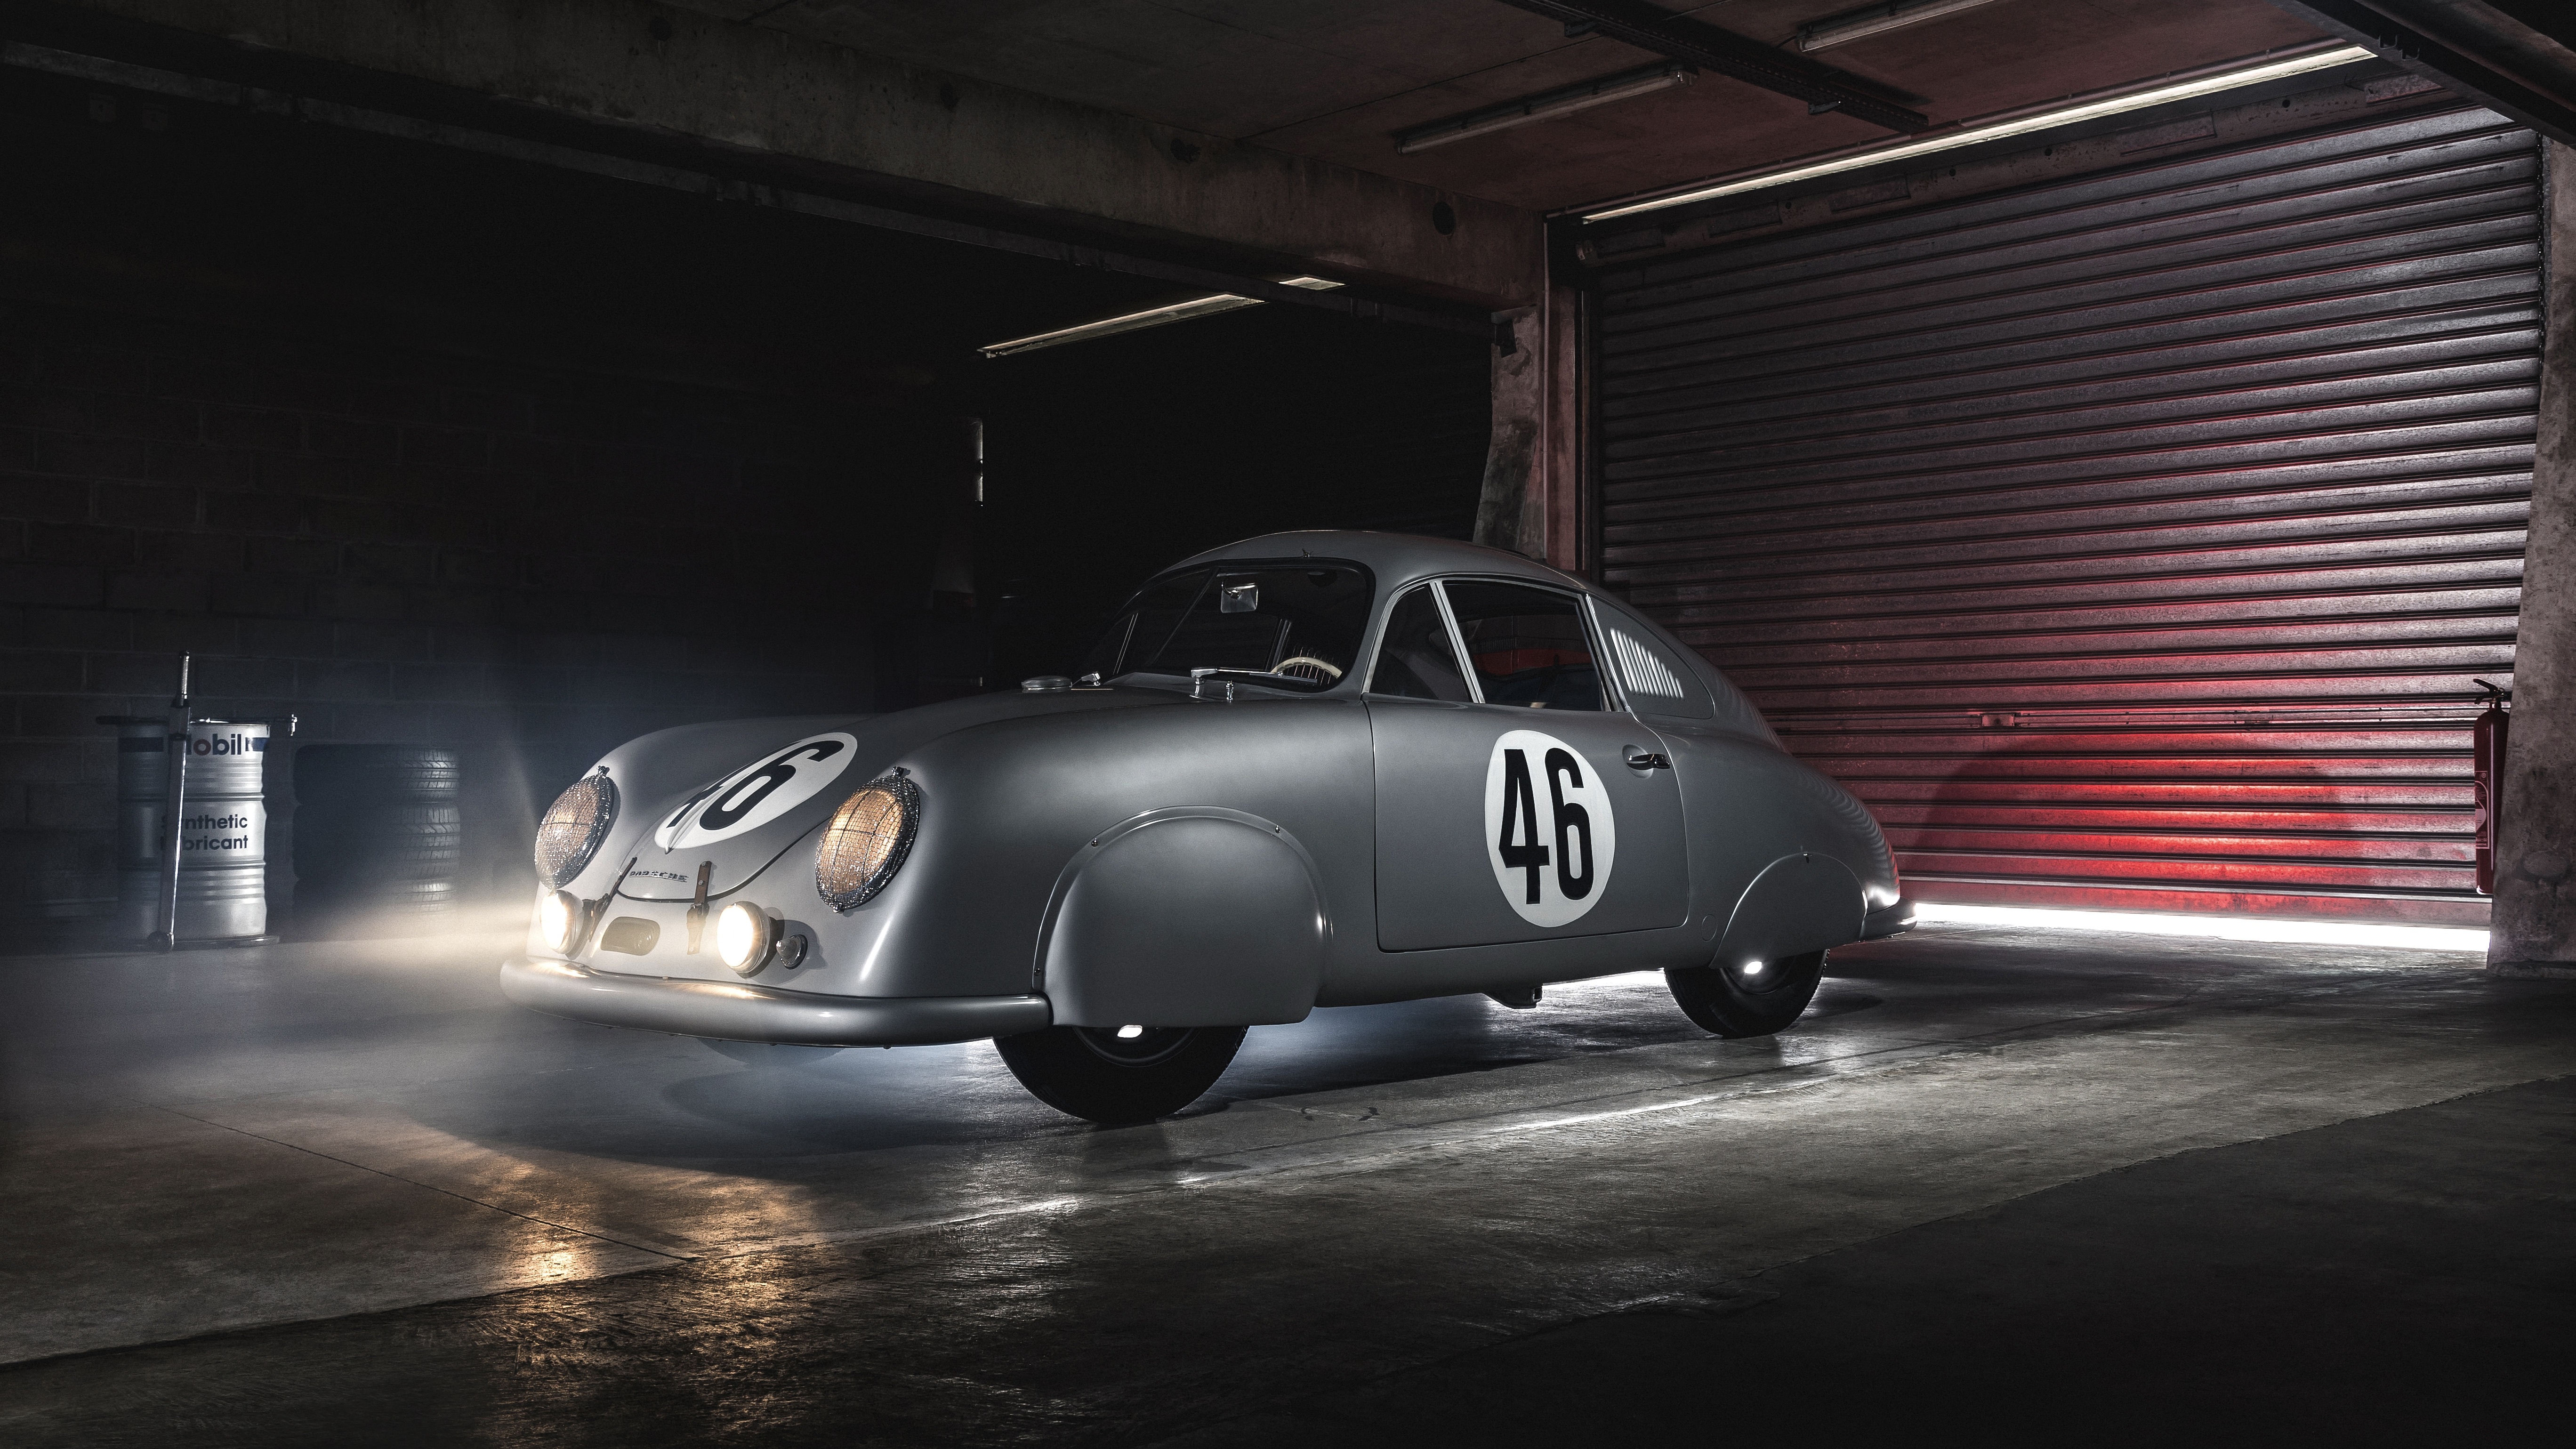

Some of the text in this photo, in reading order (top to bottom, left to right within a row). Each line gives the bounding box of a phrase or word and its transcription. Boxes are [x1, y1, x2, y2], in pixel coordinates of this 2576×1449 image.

[186, 733, 242, 756] obil
[161, 814, 248, 829] nthetic
[1498, 748, 1594, 905] 46
[160, 835, 248, 850] bricant
